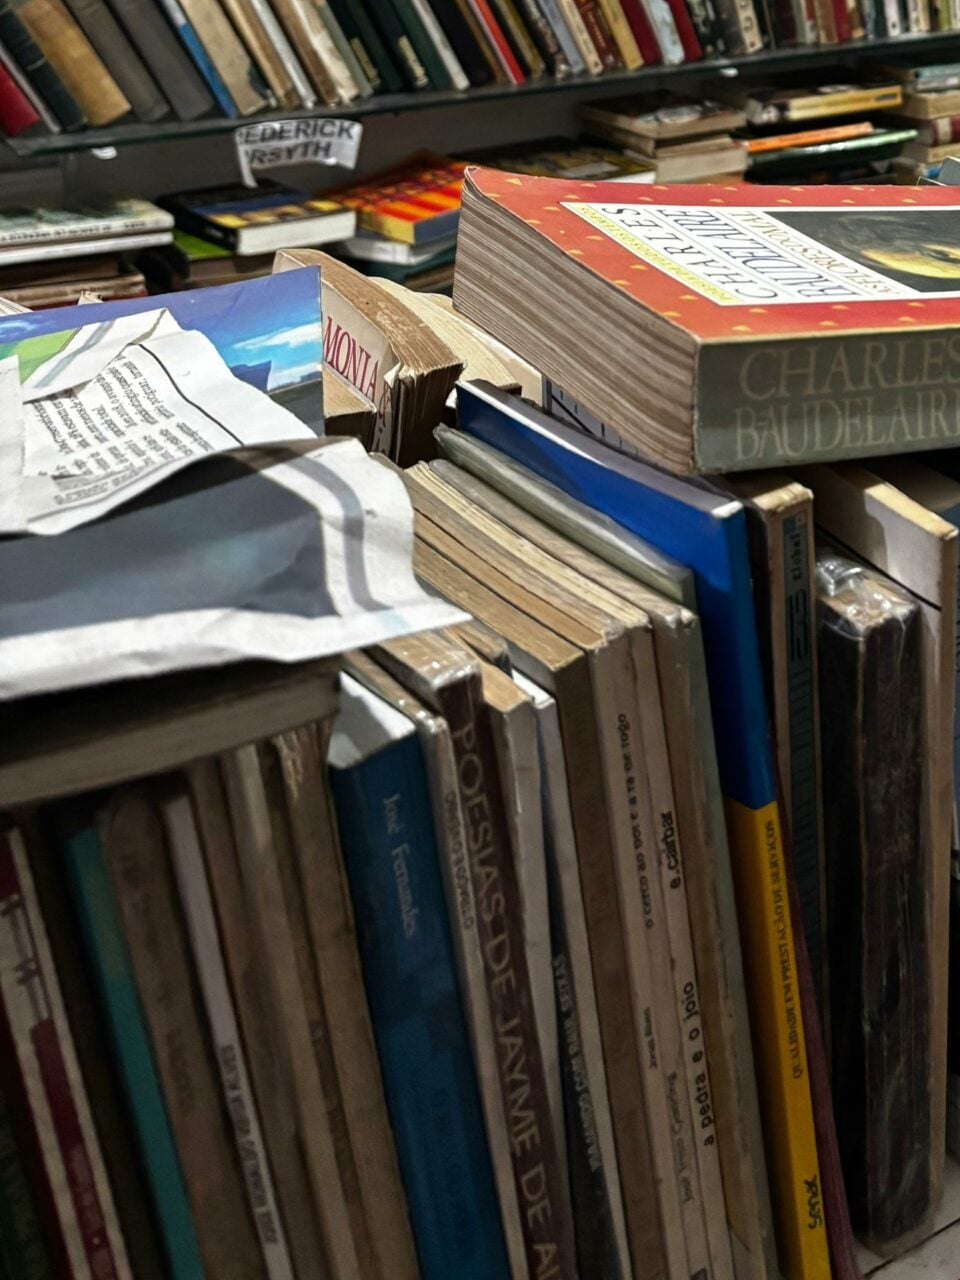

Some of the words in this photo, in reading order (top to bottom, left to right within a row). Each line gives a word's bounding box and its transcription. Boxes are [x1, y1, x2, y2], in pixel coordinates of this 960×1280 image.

[601, 206, 778, 300] CHARLES
[654, 208, 860, 299] BAUDELAIRE
[382, 793, 404, 836] José
[451, 721, 506, 919] POESIAS
[392, 842, 420, 939] Fernandes
[484, 932, 516, 998] DE
[681, 982, 700, 1019] joio
[687, 1028, 700, 1041] o
[691, 1051, 703, 1062] e
[787, 1005, 803, 1079] QUALIDADE
[496, 1017, 540, 1158] JAYME
[695, 1073, 716, 1129] pedra
[703, 1135, 714, 1146] a
[519, 1162, 552, 1229] DE
